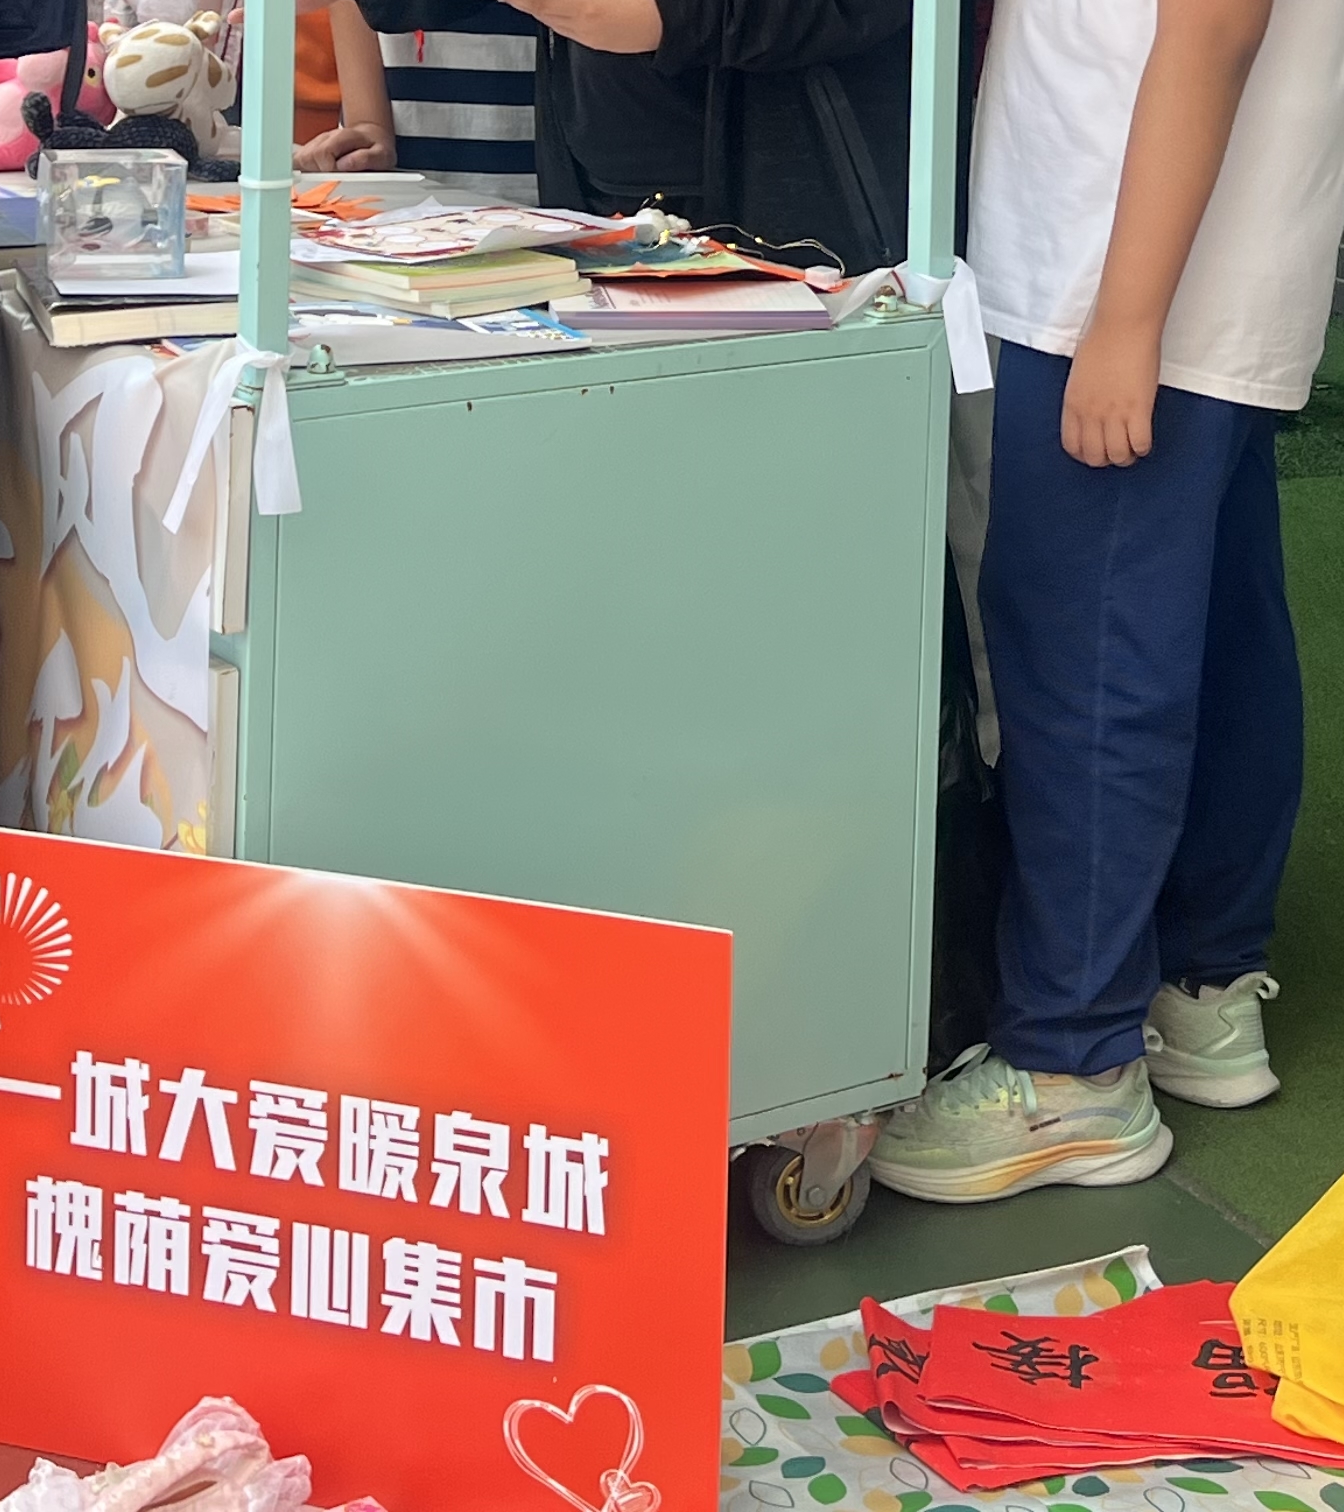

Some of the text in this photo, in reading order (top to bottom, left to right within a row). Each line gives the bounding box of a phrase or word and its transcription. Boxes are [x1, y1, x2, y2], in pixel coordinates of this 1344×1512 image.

[25, 1174, 558, 1362] 槐荫爱心集市
